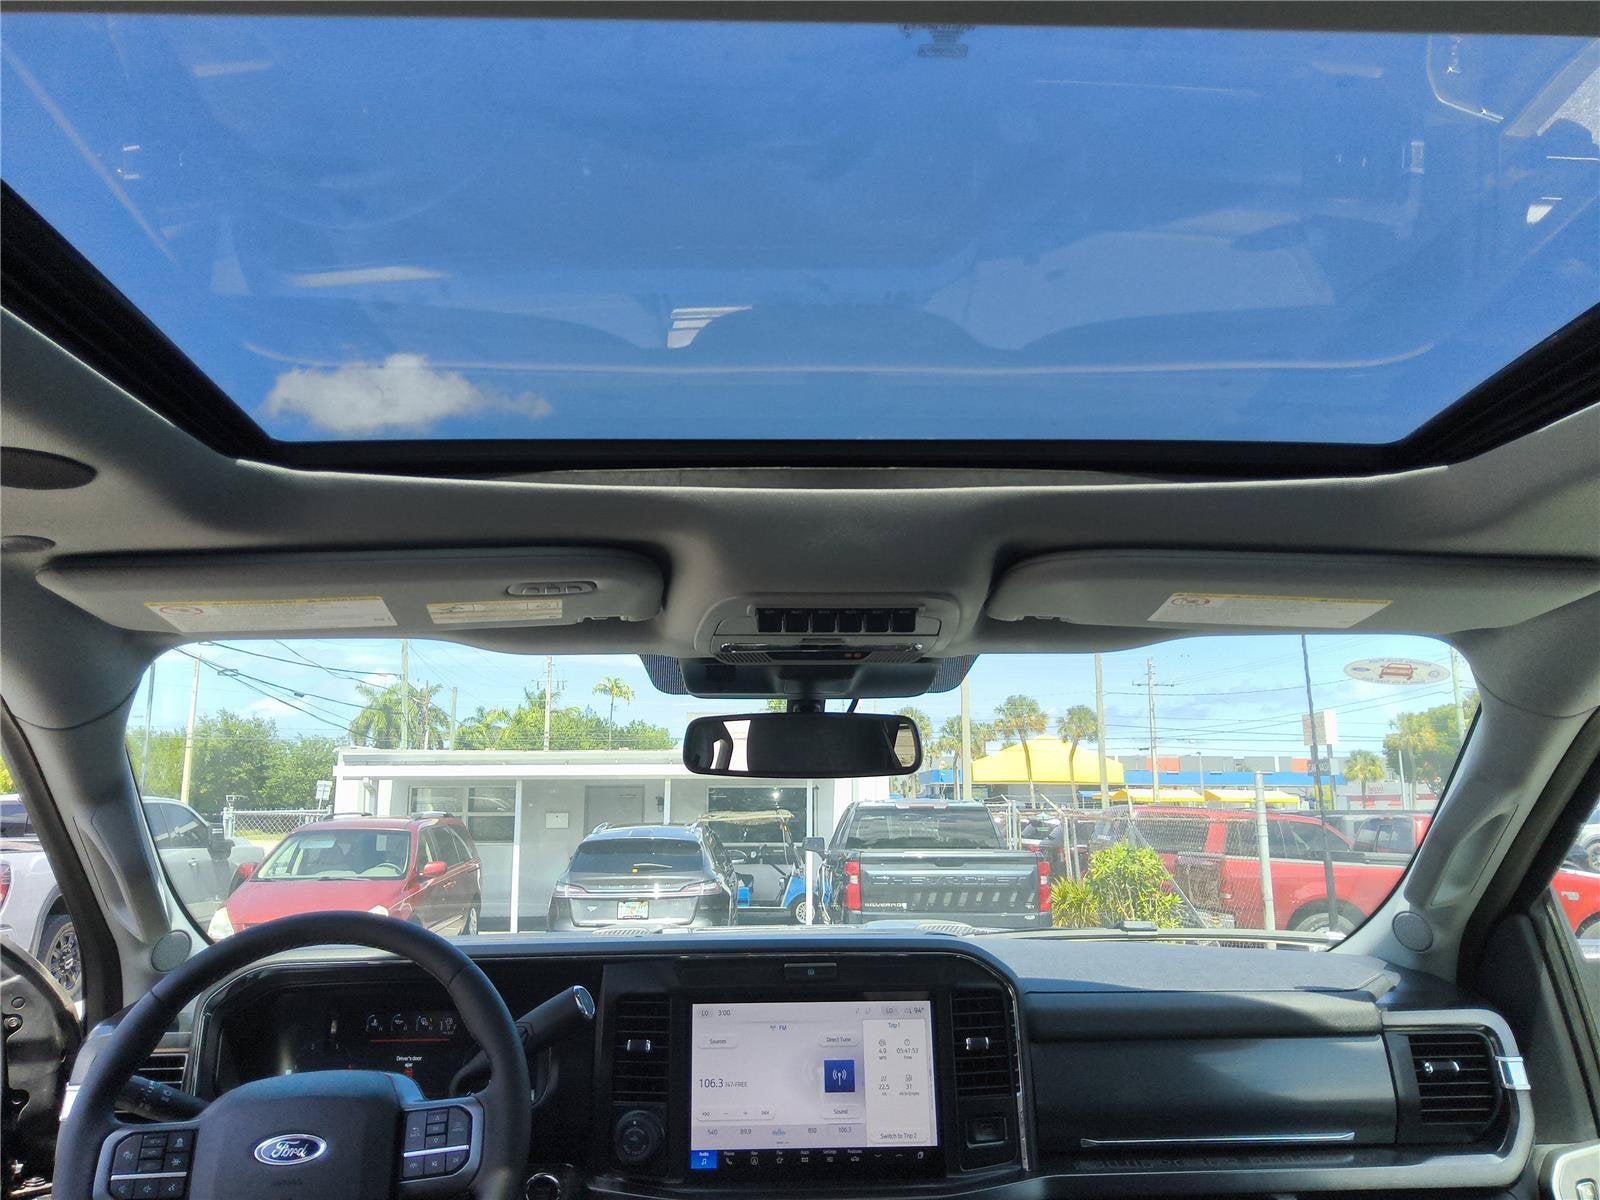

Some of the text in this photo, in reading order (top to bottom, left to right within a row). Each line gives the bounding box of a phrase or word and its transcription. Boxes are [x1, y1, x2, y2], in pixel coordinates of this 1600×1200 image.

[717, 1009, 731, 1017] 3:00
[699, 1078, 724, 1088] 106.3
[904, 1132, 913, 1140] Trip
[271, 1140, 308, 1159] Ford
